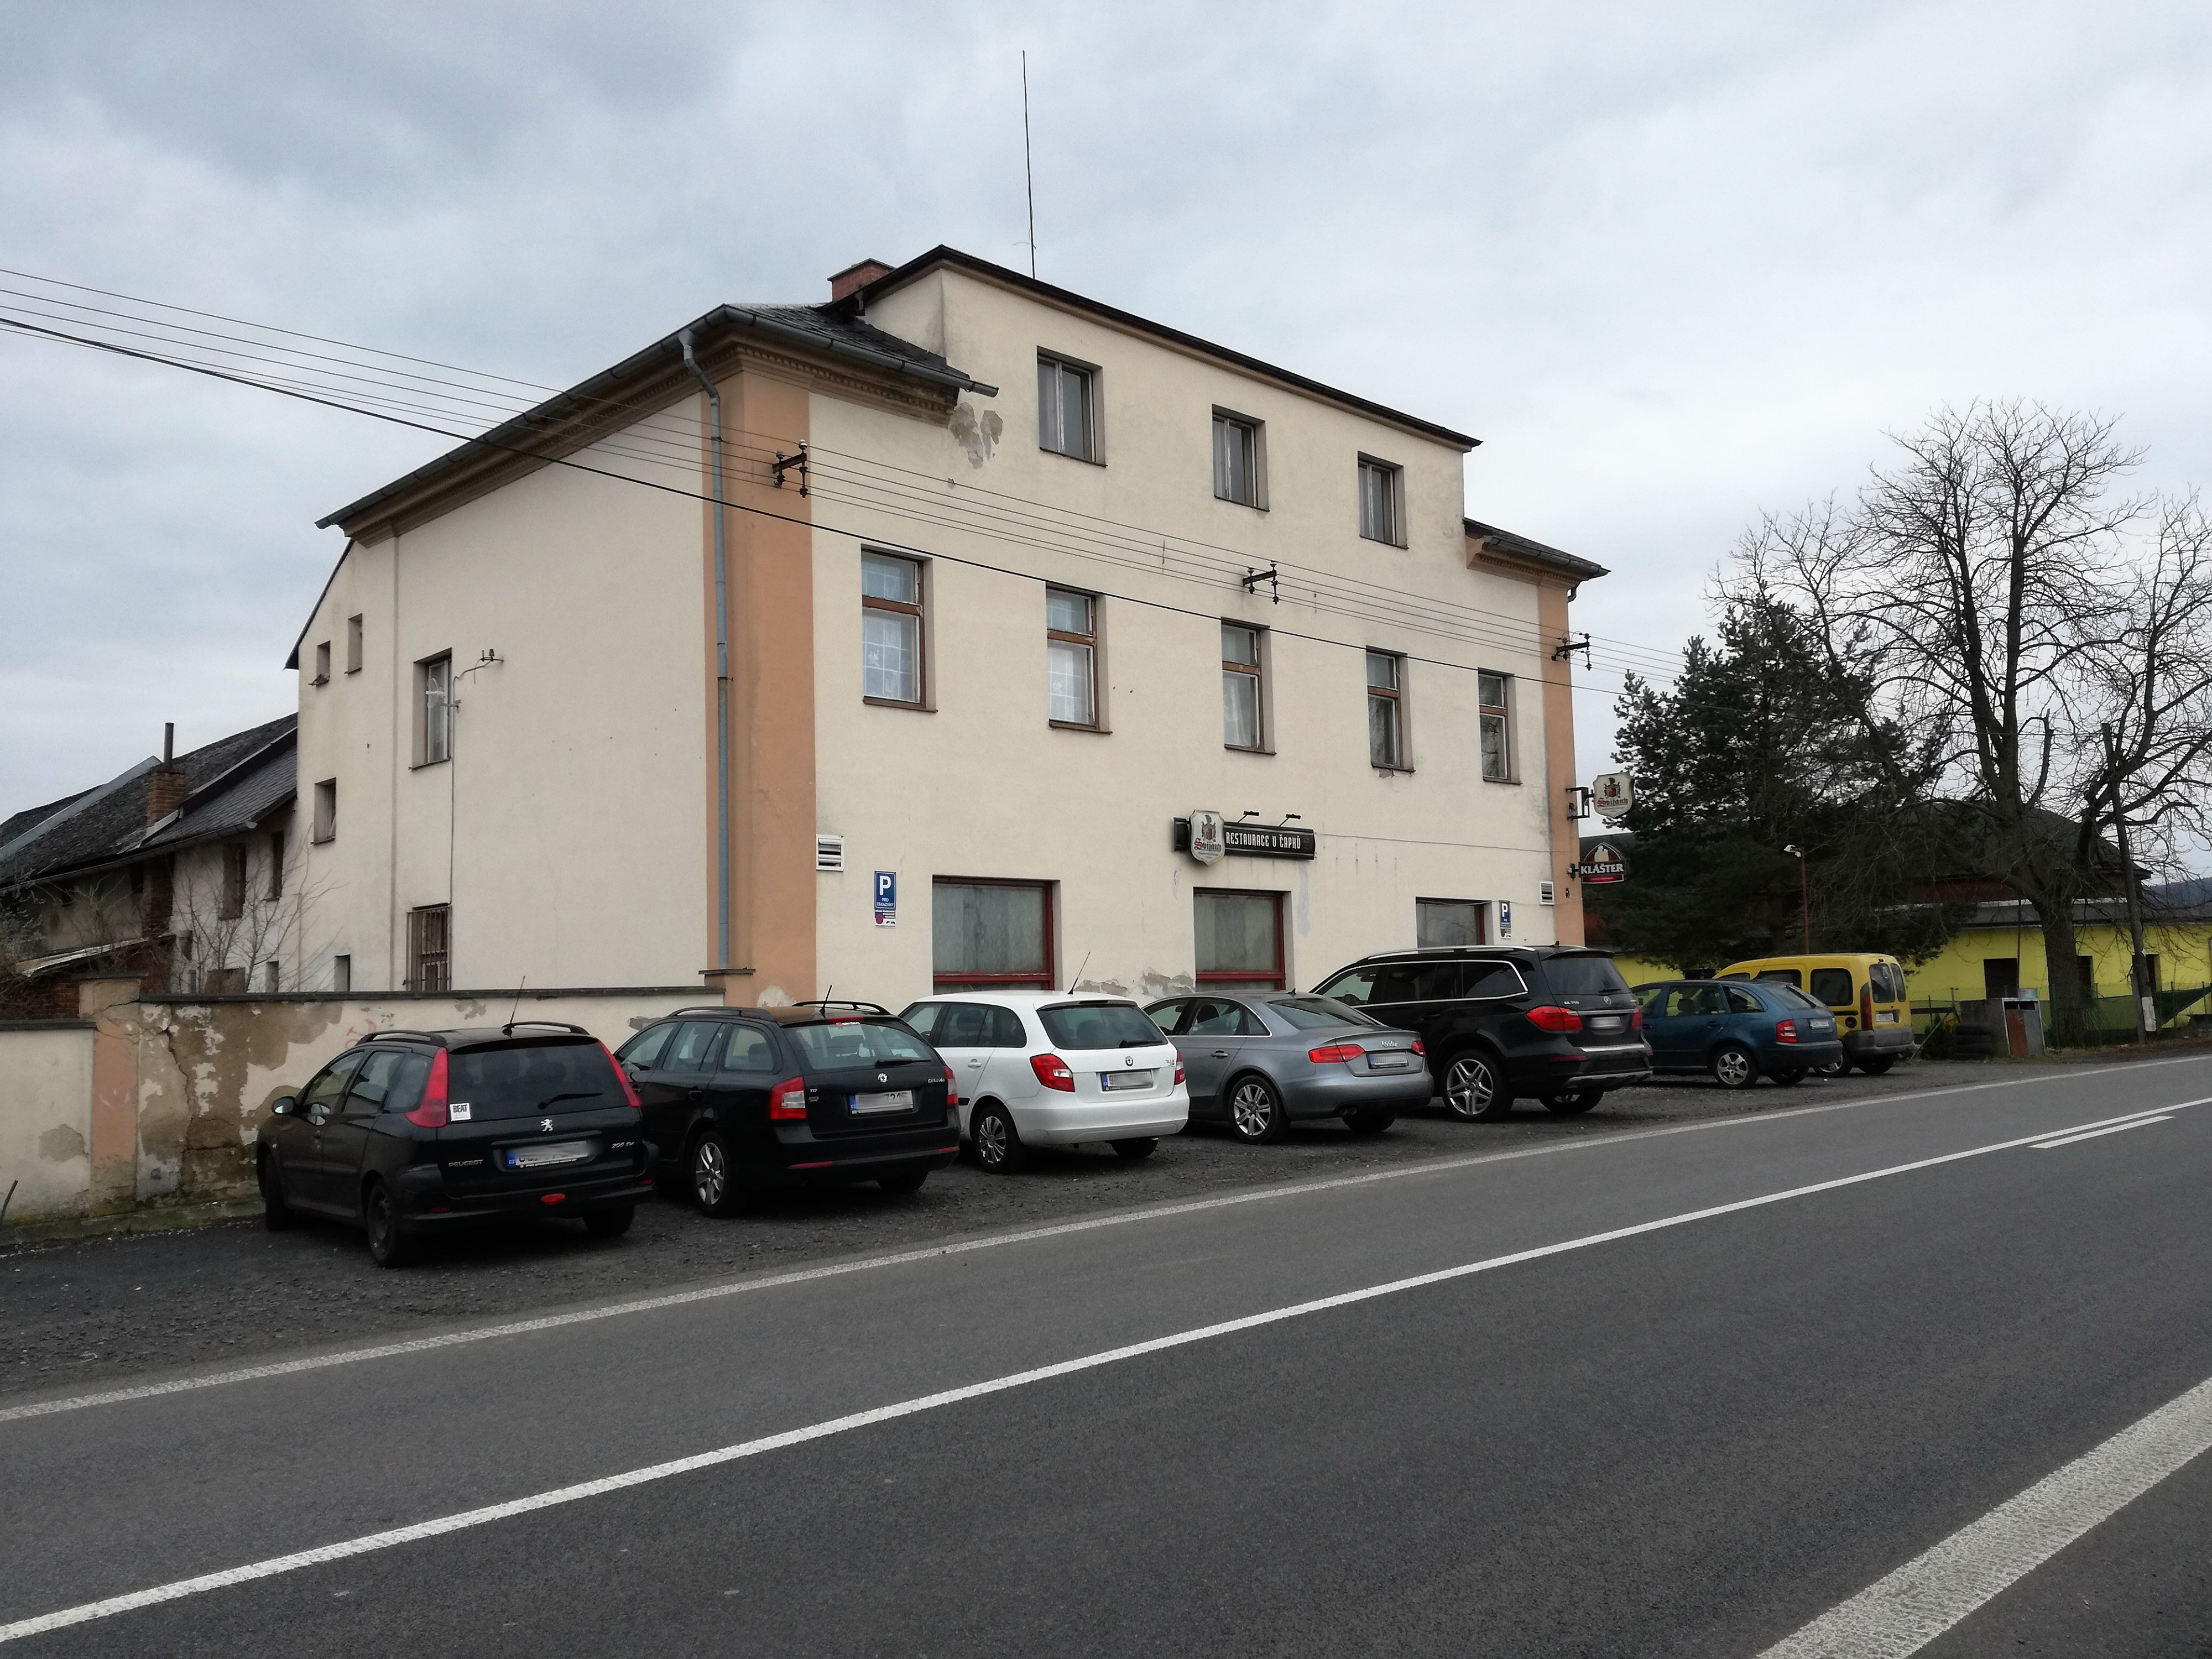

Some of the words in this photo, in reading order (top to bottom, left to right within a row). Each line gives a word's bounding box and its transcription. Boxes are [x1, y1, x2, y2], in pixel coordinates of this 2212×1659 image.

[1597, 797, 1628, 807] Svijany
[1194, 837, 1222, 852] Svijany
[1225, 832, 1269, 847] RESTAURACE
[1272, 835, 1277, 848] U
[1279, 834, 1301, 849] ČAPKŮ
[1580, 863, 1624, 874] KLÁŠTER
[879, 875, 891, 896] P
[1501, 903, 1508, 917] P
[453, 1104, 467, 1113] BEAT
[448, 1159, 484, 1167] PEUGEOT
